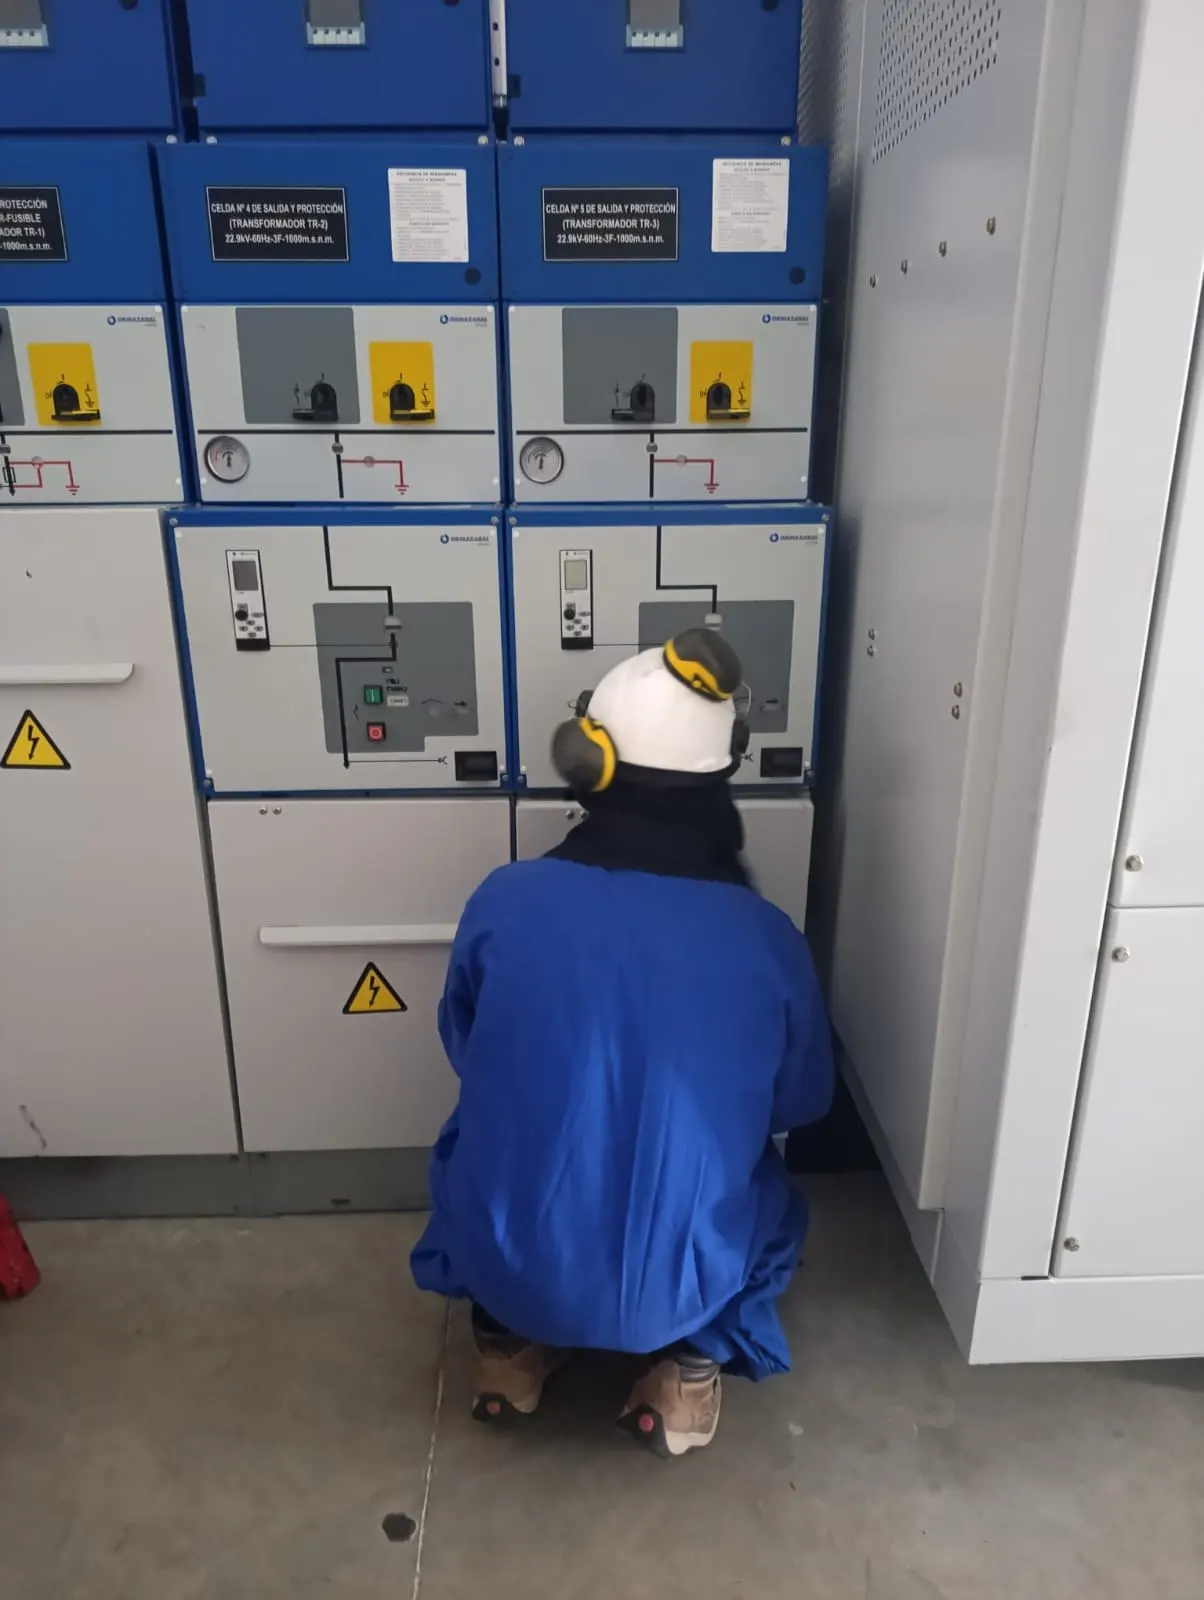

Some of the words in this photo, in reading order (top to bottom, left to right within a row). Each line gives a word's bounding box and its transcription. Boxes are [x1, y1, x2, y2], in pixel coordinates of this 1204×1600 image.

[211, 203, 235, 213] CELDA
[246, 203, 251, 213] 4
[252, 203, 262, 213] DE
[263, 203, 290, 214] SALIDA
[290, 204, 296, 214] Y
[296, 202, 344, 214] PROTECCIÓN
[545, 203, 570, 214] CELDA
[580, 204, 585, 214] 5
[586, 203, 596, 214] DE
[597, 203, 623, 214] SALIDA
[624, 204, 630, 214] Y
[630, 202, 676, 214] PROTECCIÓN
[229, 218, 306, 230] (TRANSFORMADOR
[307, 218, 329, 231] TR-2)
[562, 218, 638, 231] (TRANSFORMADOR
[640, 218, 660, 231] TR-3)
[23, 227, 46, 239] TR-1)
